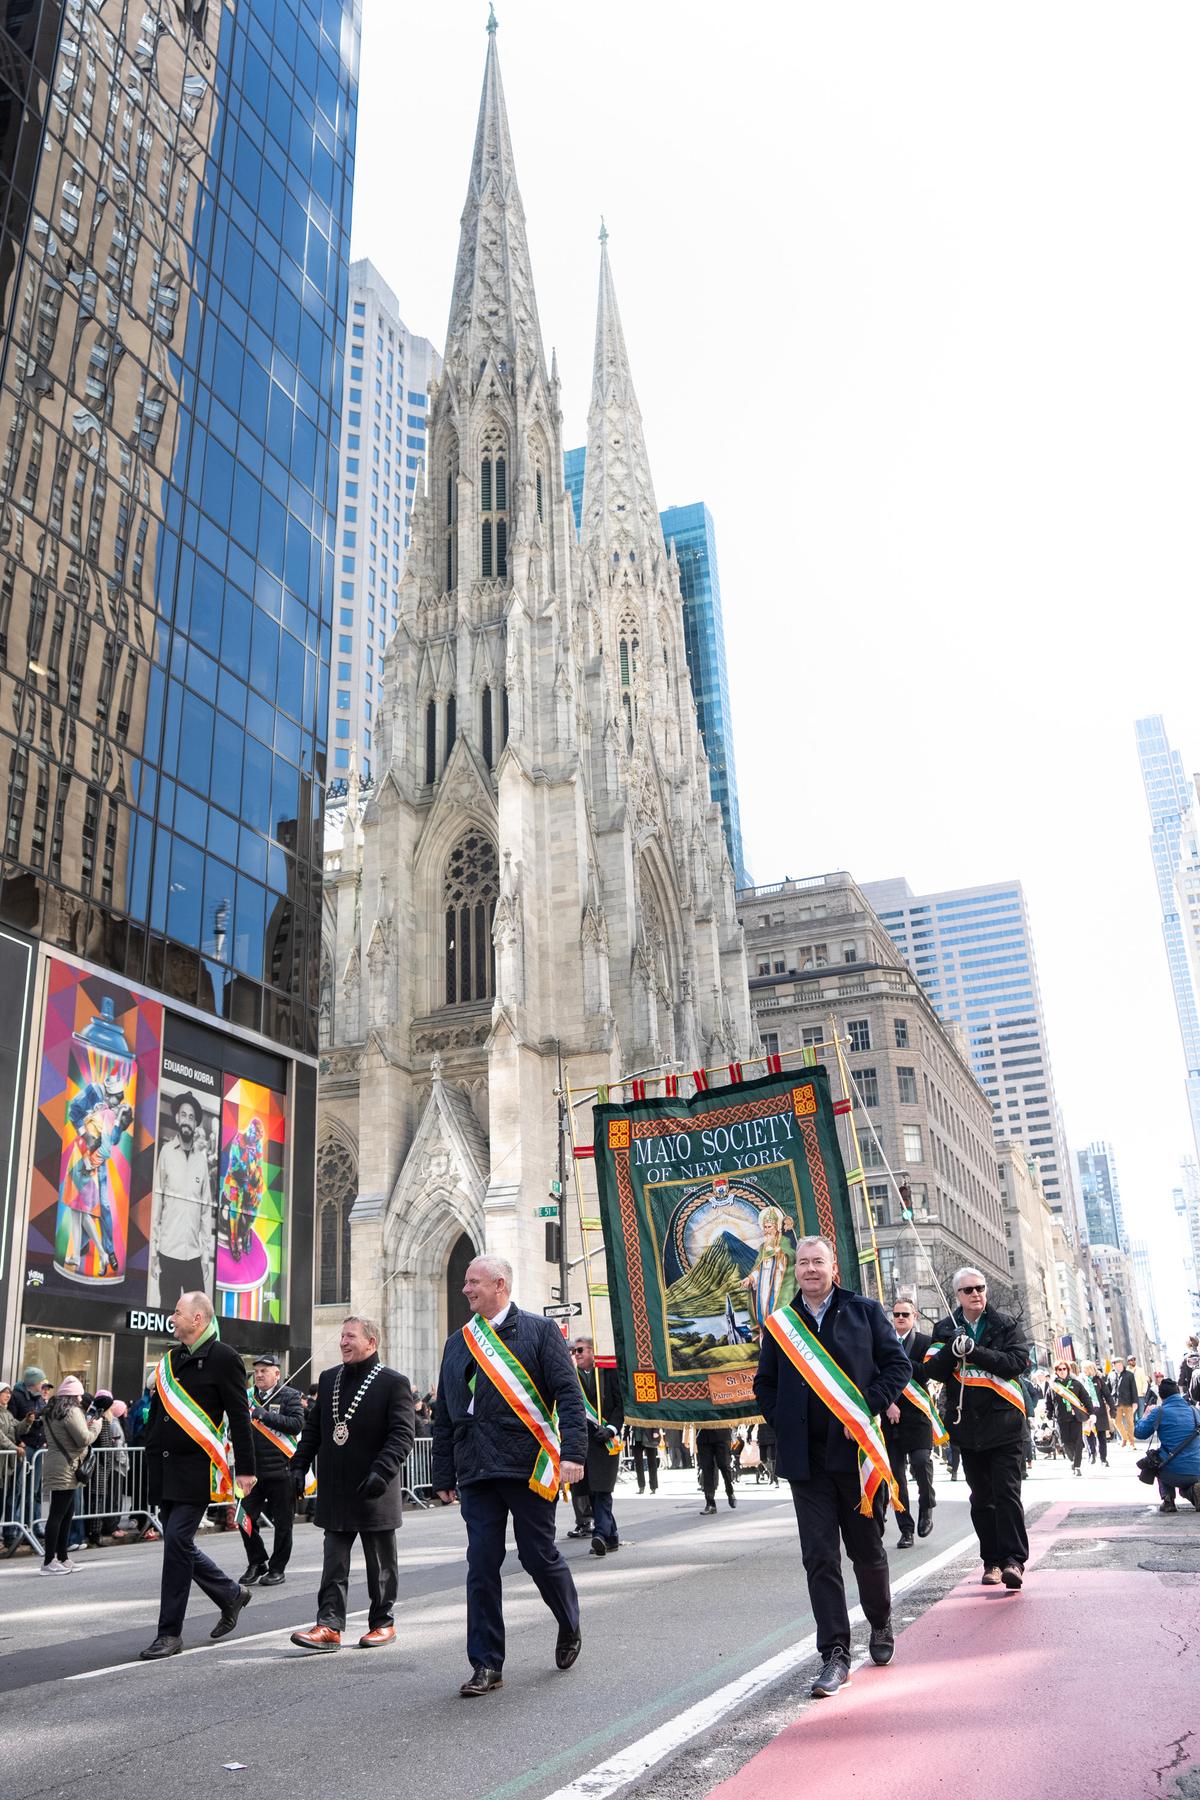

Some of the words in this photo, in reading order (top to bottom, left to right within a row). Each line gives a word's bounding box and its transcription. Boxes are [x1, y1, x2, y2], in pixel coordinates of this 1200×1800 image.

[163, 1059, 193, 1078] EDUARDO
[194, 1070, 214, 1086] KOBRA
[634, 1133, 691, 1165] MAYO
[701, 1112, 794, 1156] SOCIETY
[647, 1168, 672, 1183] OF
[680, 1158, 723, 1180] NEW
[732, 1146, 786, 1170] YORK
[544, 1207, 551, 1216] 51
[130, 1310, 165, 1332] EDEN
[472, 1325, 495, 1357] MAYO
[785, 1328, 815, 1361] MAYO
